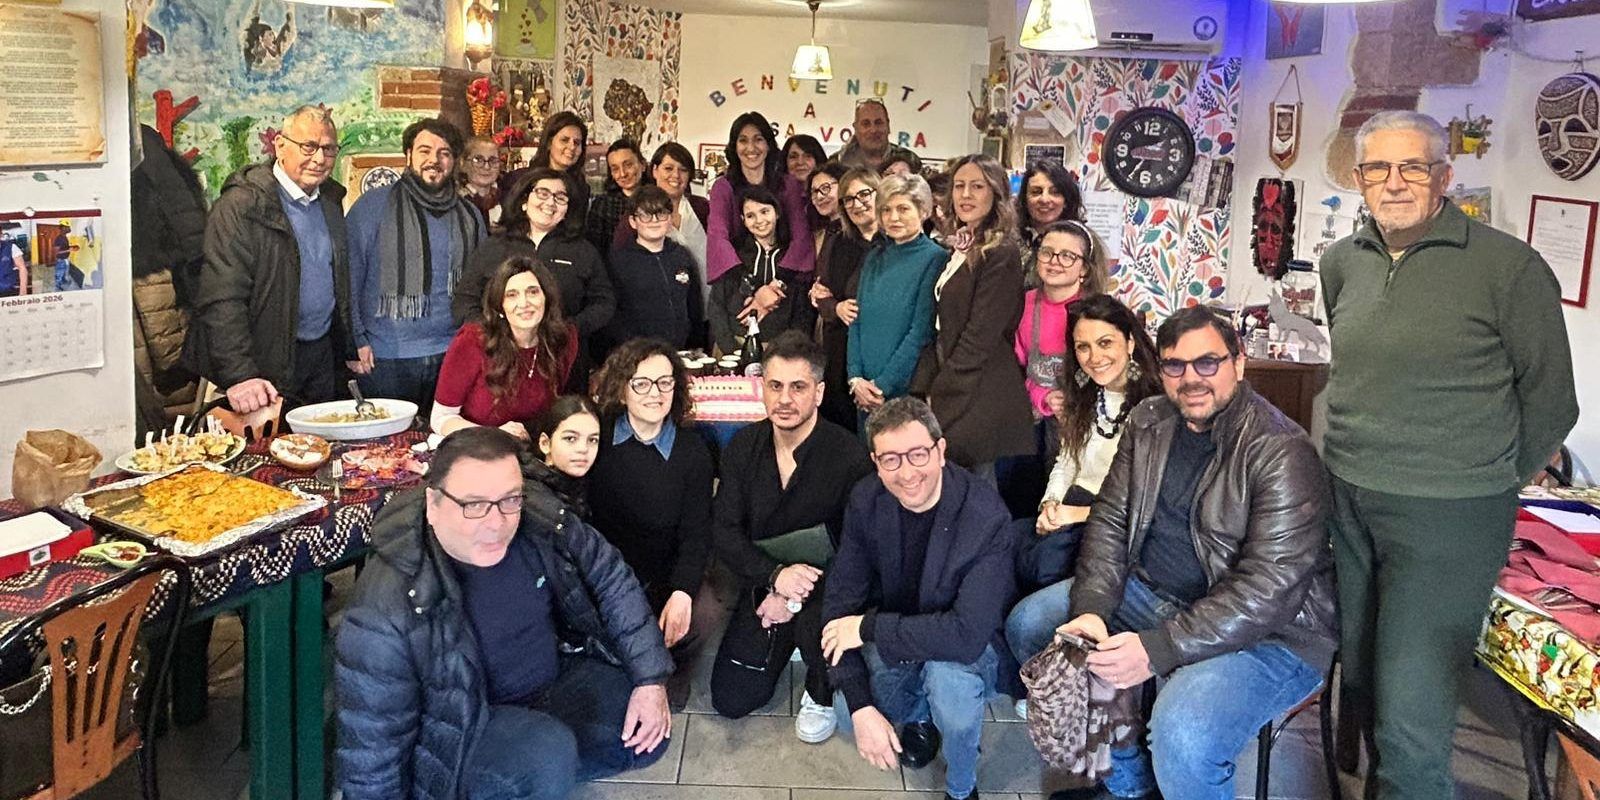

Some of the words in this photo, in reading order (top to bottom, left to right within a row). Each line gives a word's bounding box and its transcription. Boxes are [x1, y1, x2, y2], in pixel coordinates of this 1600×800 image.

[709, 75, 932, 112] BENVENUTI
[803, 102, 816, 119] A
[1143, 121, 1161, 136] 12
[820, 127, 927, 148] VORA
[1116, 143, 1129, 158] 9
[1168, 148, 1181, 162] 3
[1139, 170, 1152, 184] 6
[1, 298, 41, 307] Febbraio
[42, 294, 64, 303] 2026
